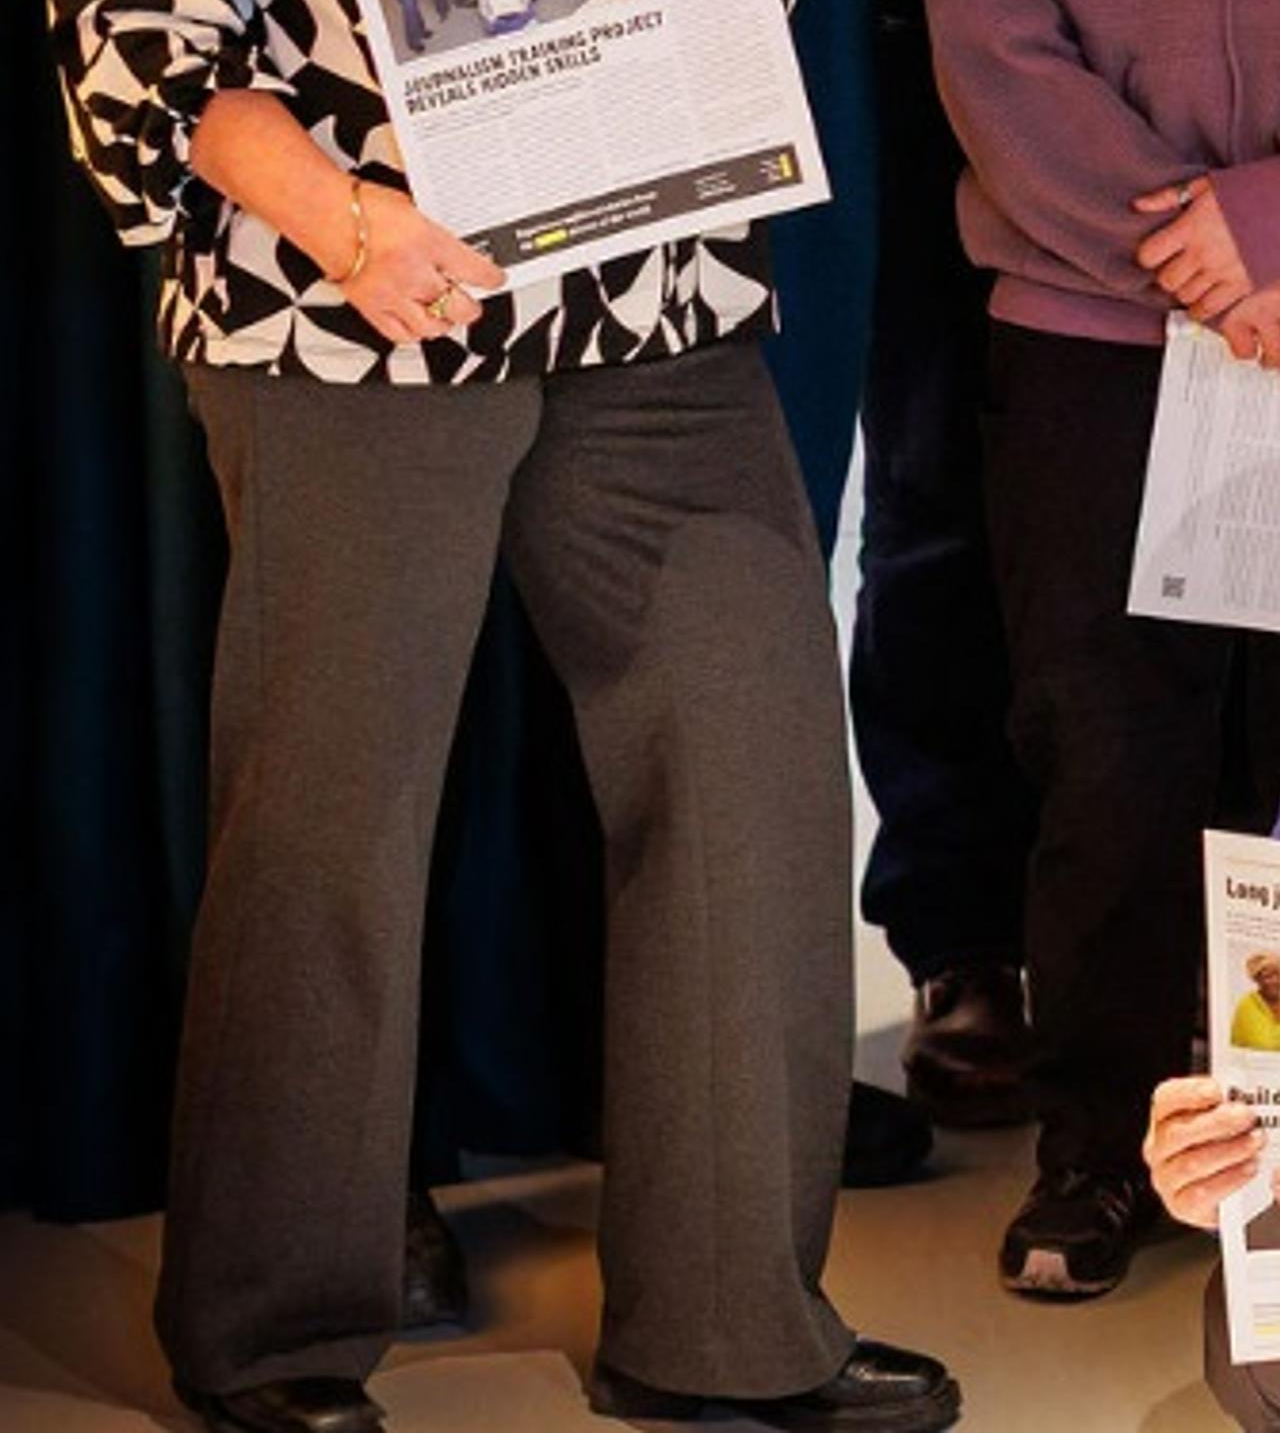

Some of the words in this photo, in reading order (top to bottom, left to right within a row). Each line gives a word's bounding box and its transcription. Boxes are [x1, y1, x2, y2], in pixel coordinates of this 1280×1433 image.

[404, 53, 506, 96] JOURNALISM
[508, 30, 587, 66] TRAINING
[590, 11, 664, 43] PROJECT
[405, 80, 477, 115] REVEALS
[480, 62, 541, 93] HIDDEN
[543, 46, 602, 75] SKILLS
[1225, 876, 1270, 907] Long
